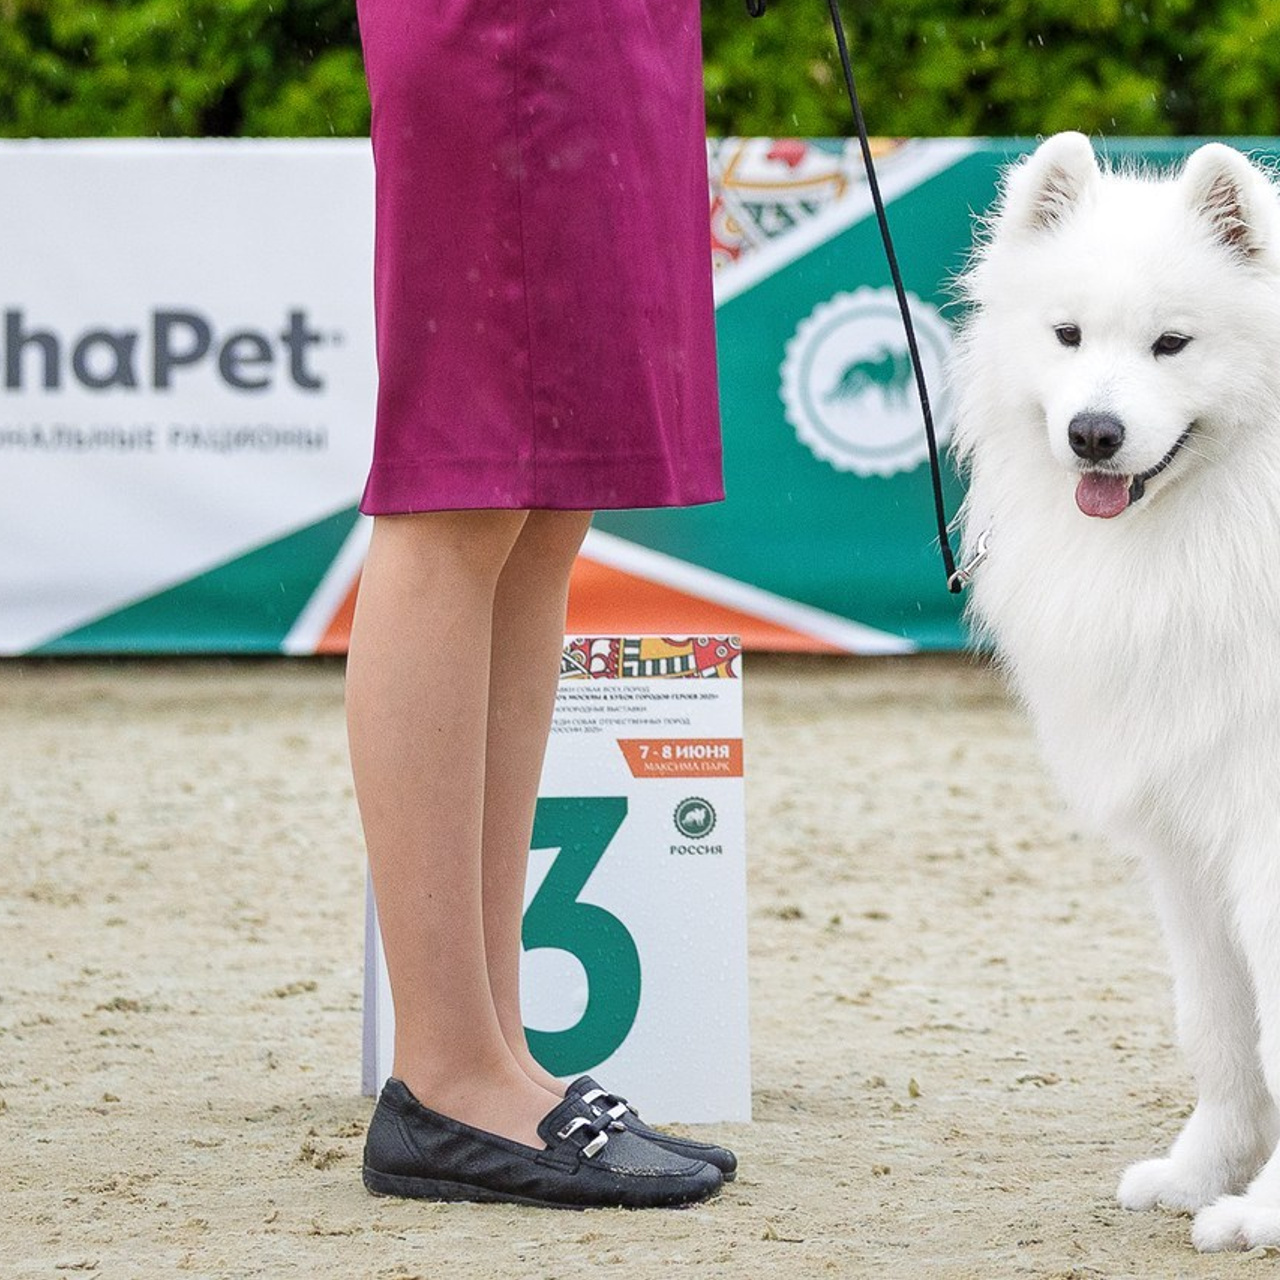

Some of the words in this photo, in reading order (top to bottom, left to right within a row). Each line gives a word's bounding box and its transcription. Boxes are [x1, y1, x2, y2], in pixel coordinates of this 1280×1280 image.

[639, 745, 650, 760] 7
[661, 745, 673, 759] 8
[675, 745, 729, 759] ИЮНЯ
[644, 762, 701, 772] МАКСИМА
[702, 761, 730, 772] ПАРК
[669, 845, 723, 856] РОССИЯ
[521, 796, 641, 1077] 3
